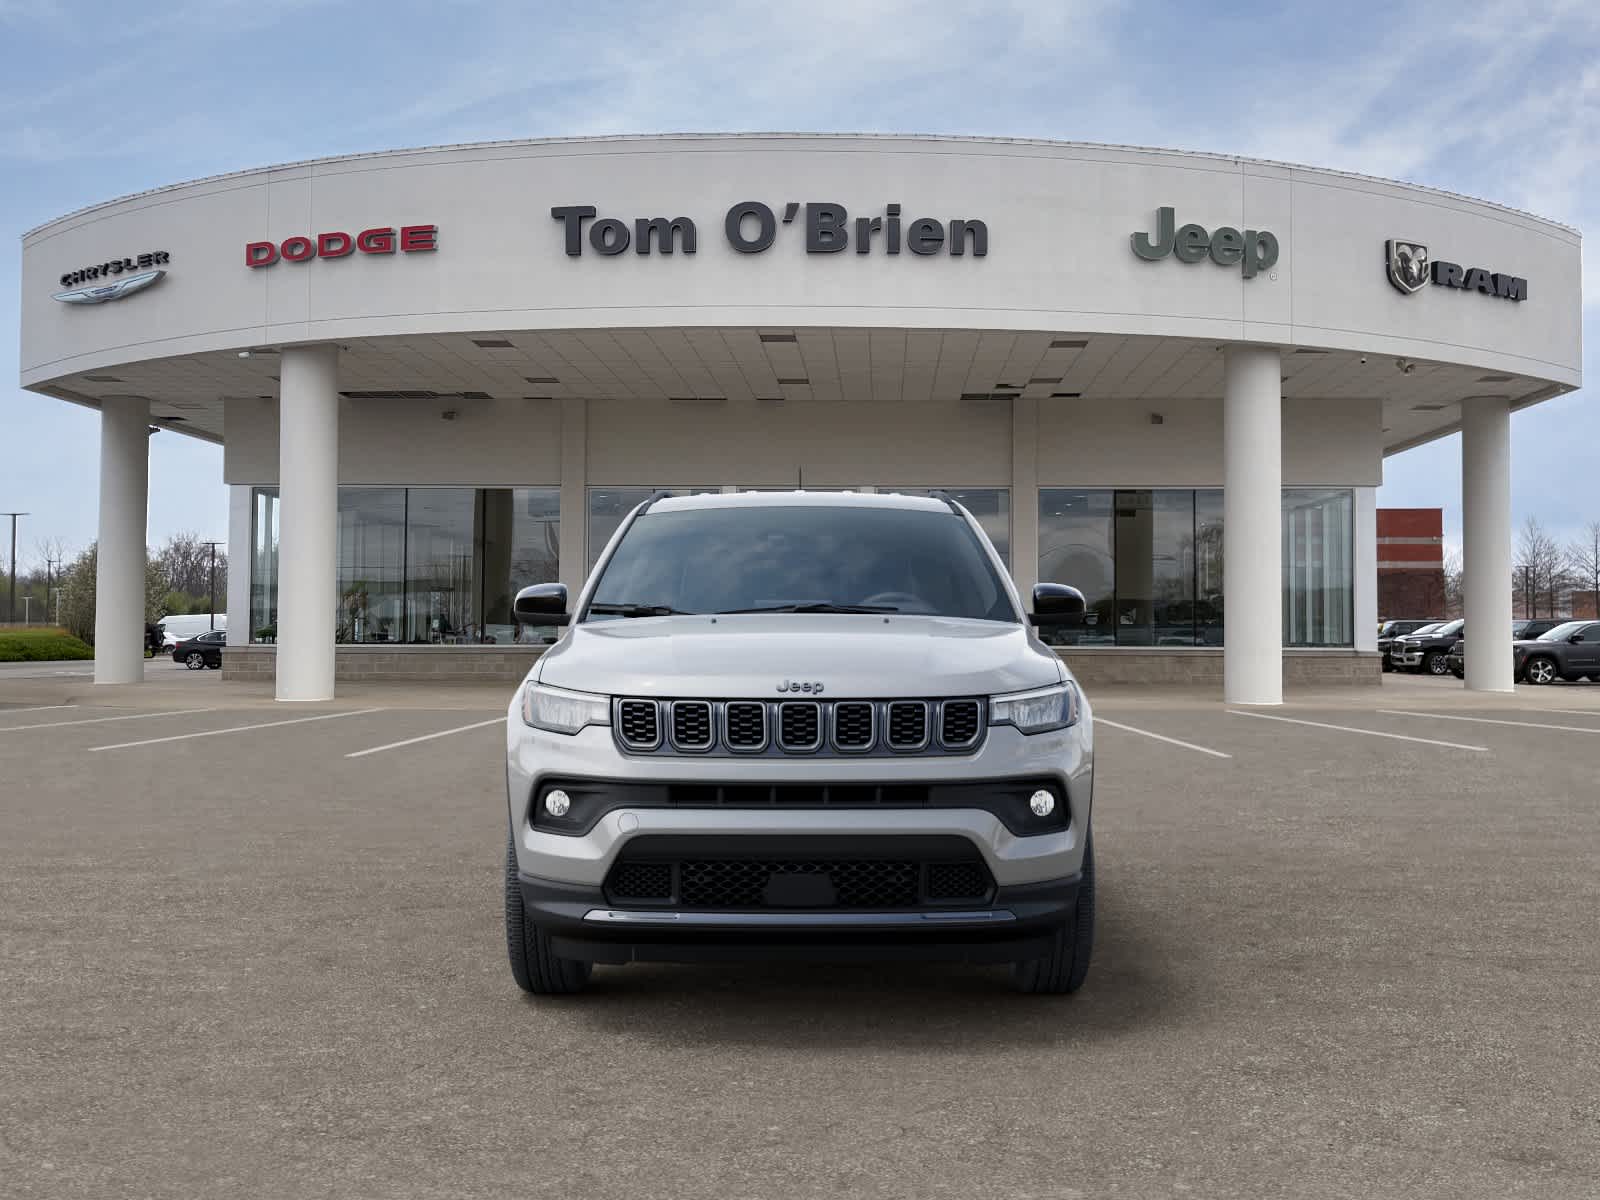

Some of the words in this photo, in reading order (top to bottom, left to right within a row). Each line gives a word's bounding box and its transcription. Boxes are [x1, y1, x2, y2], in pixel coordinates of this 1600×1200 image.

[245, 224, 437, 269] DODGE
[551, 205, 697, 256] Tom
[724, 201, 988, 256] O'Brien
[1130, 206, 1279, 279] Jeep
[60, 250, 170, 287] CHRYSLER
[1431, 261, 1528, 301] RAM
[776, 680, 824, 695] Jeep
